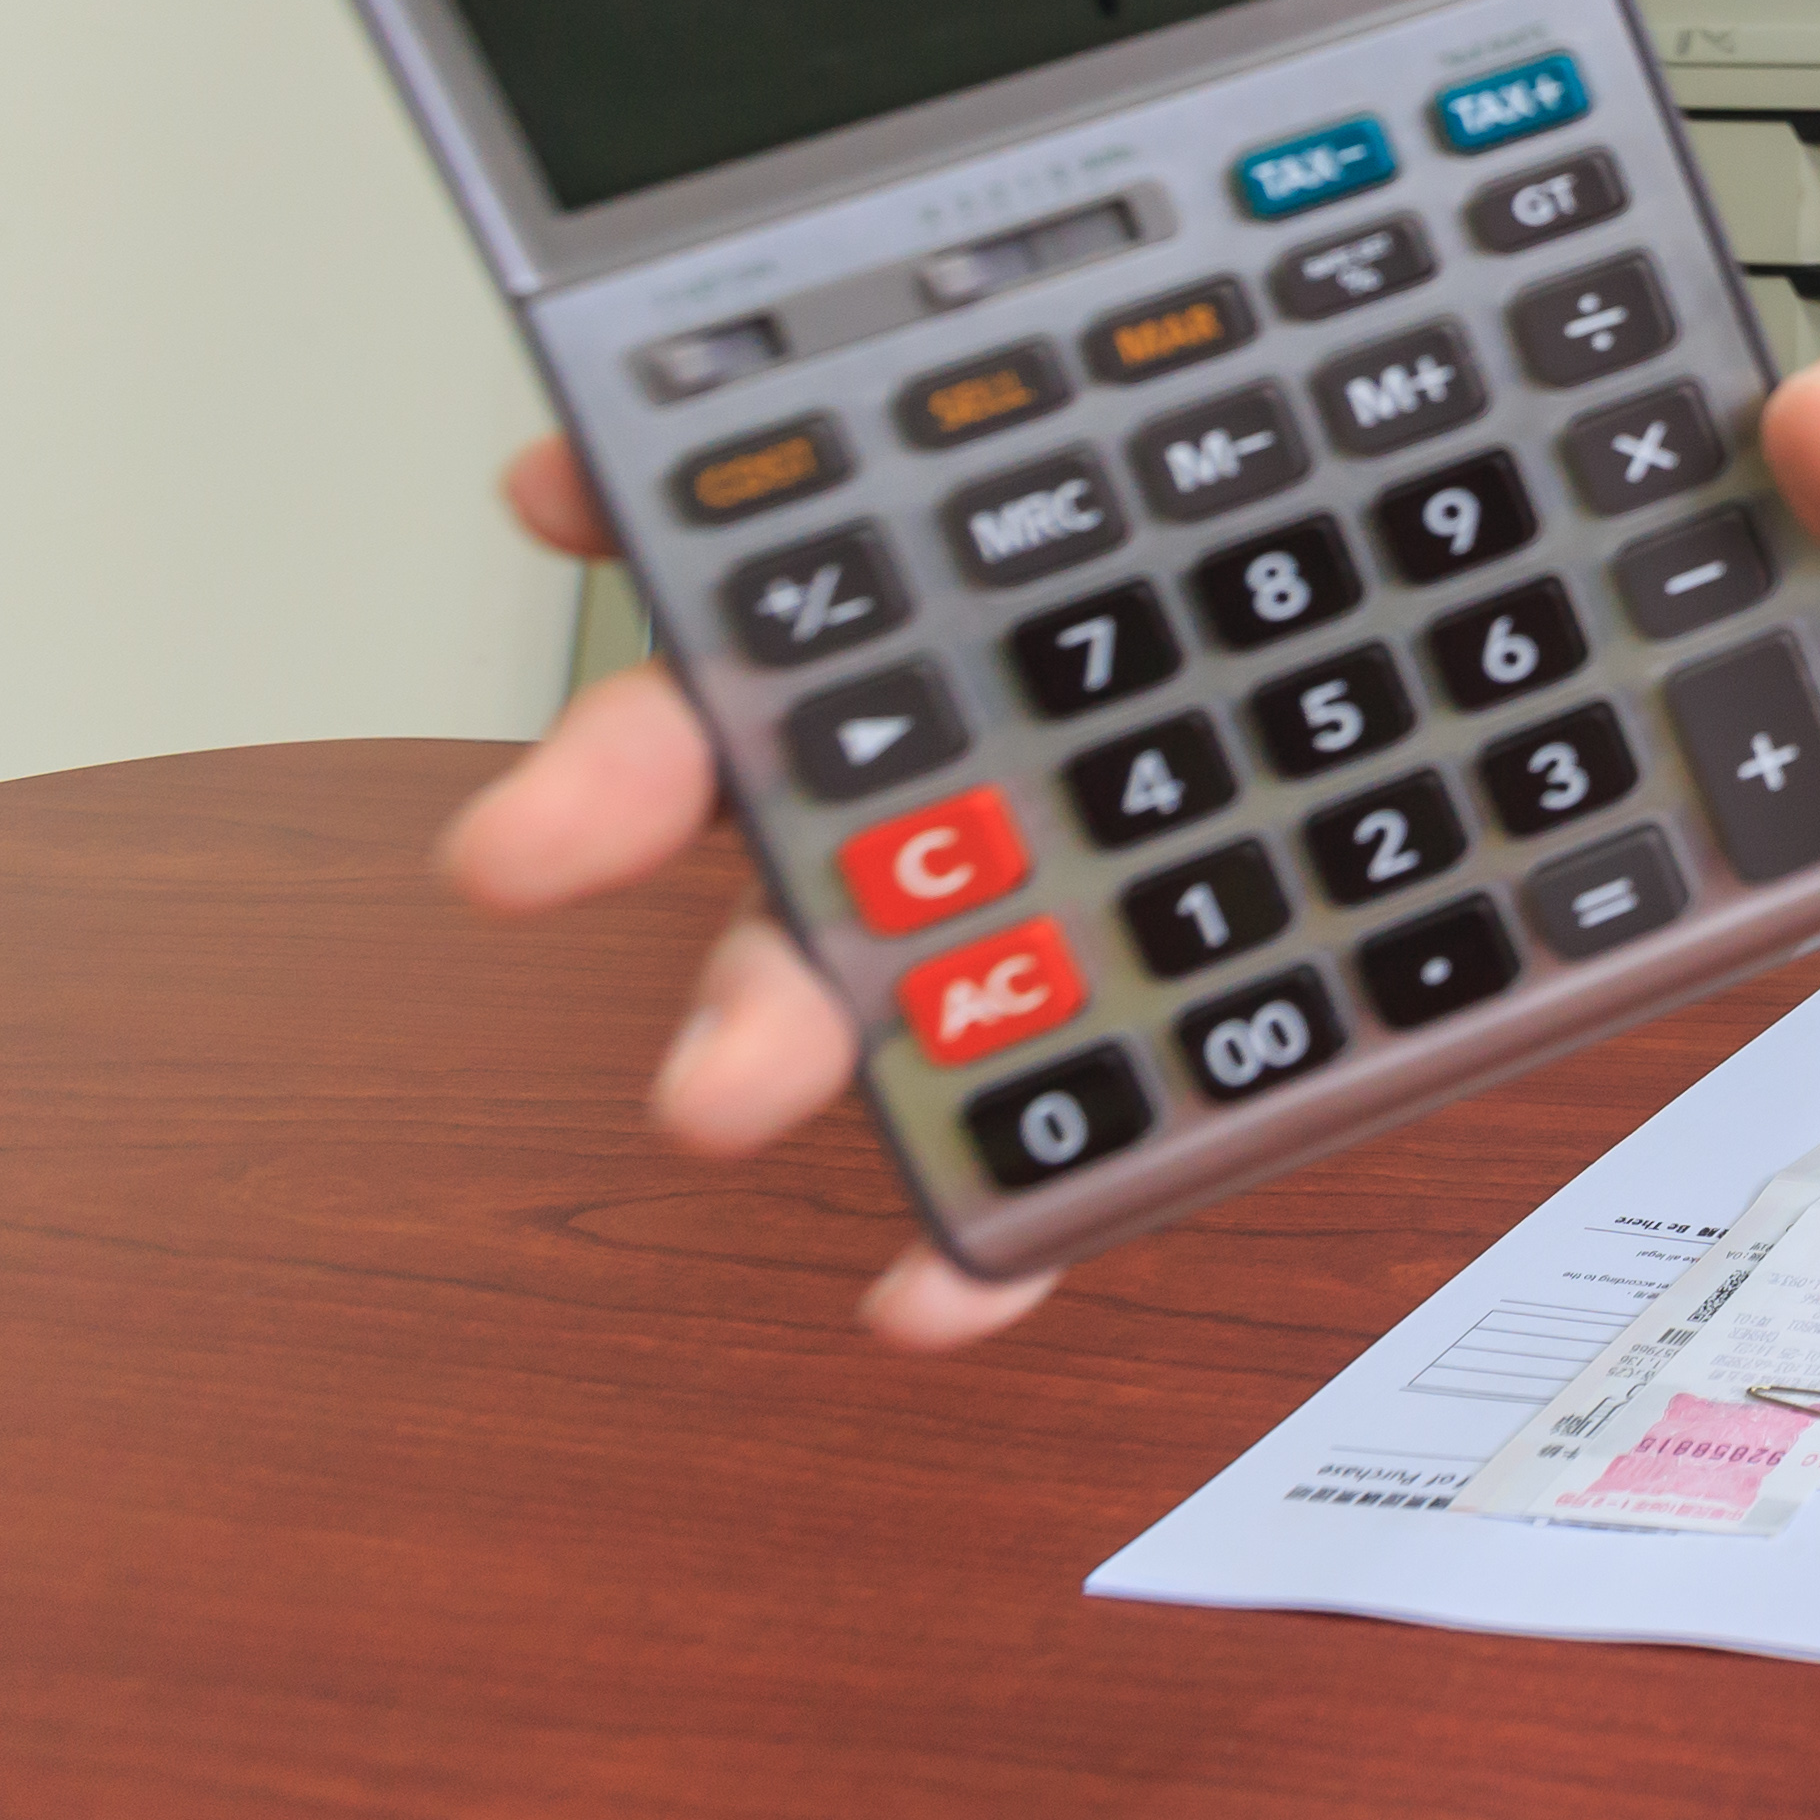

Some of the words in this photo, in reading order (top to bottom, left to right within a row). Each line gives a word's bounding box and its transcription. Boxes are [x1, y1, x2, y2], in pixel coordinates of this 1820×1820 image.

[1446, 71, 1570, 141] TAX+
[1508, 172, 1579, 231] GT
[1111, 299, 1220, 367] MAR
[1343, 350, 1454, 426] M+
[693, 436, 819, 511] COST
[968, 478, 1104, 561] MRC
[1422, 486, 1484, 561] 9
[1245, 549, 1313, 624] 8
[1056, 614, 1121, 693] 7
[1480, 611, 1541, 684] 6
[1299, 679, 1366, 753] 5
[1119, 747, 1184, 818] 4
[1524, 739, 1591, 813] 3
[892, 826, 977, 901] C
[1351, 809, 1421, 883] 2
[1177, 884, 1234, 951] 1
[937, 954, 1052, 1043] AC
[1202, 998, 1312, 1087] 00
[1020, 1089, 1092, 1168] 0
[1614, 1215, 1663, 1233] There
[1598, 1272, 1654, 1289] according
[1317, 1463, 1423, 1488] Purchase
